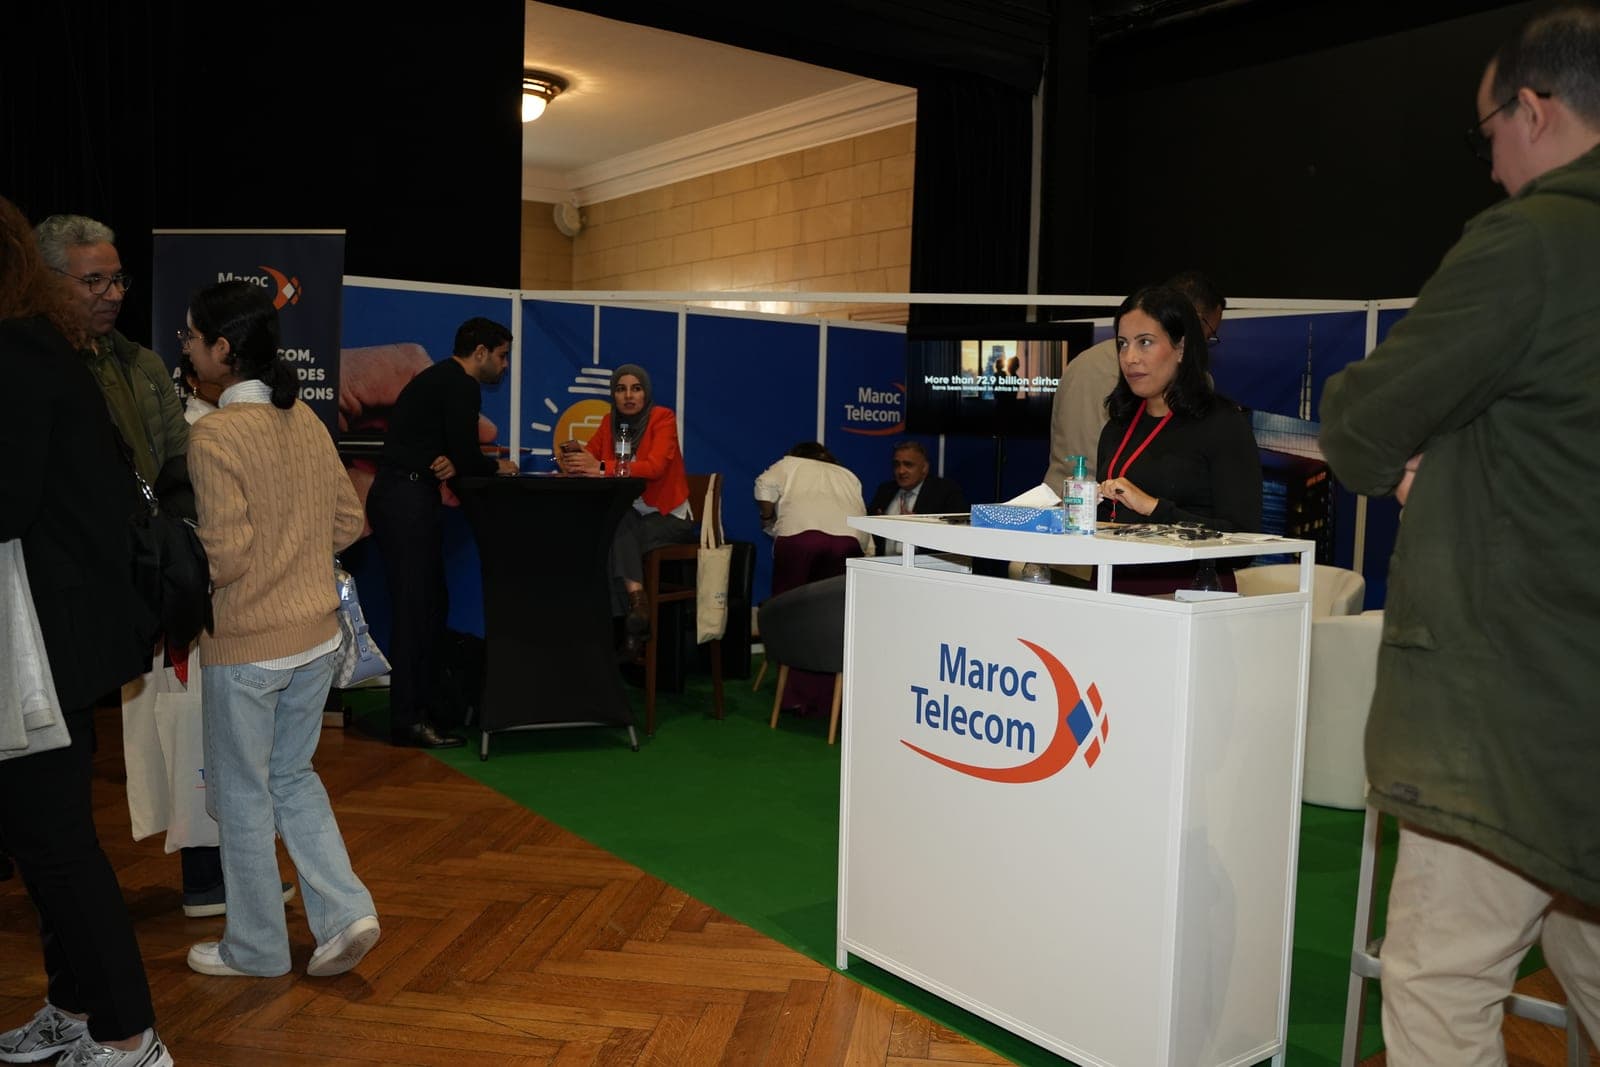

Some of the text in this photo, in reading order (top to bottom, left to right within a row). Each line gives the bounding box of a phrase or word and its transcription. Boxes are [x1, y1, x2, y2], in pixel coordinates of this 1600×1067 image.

[277, 349, 314, 364] COM,
[924, 375, 1059, 386] More than 72.9 billion dirha
[858, 387, 901, 405] Maroc
[844, 404, 901, 423] Telecom
[939, 643, 1037, 702] Maroc
[910, 685, 1036, 754] Telecom
